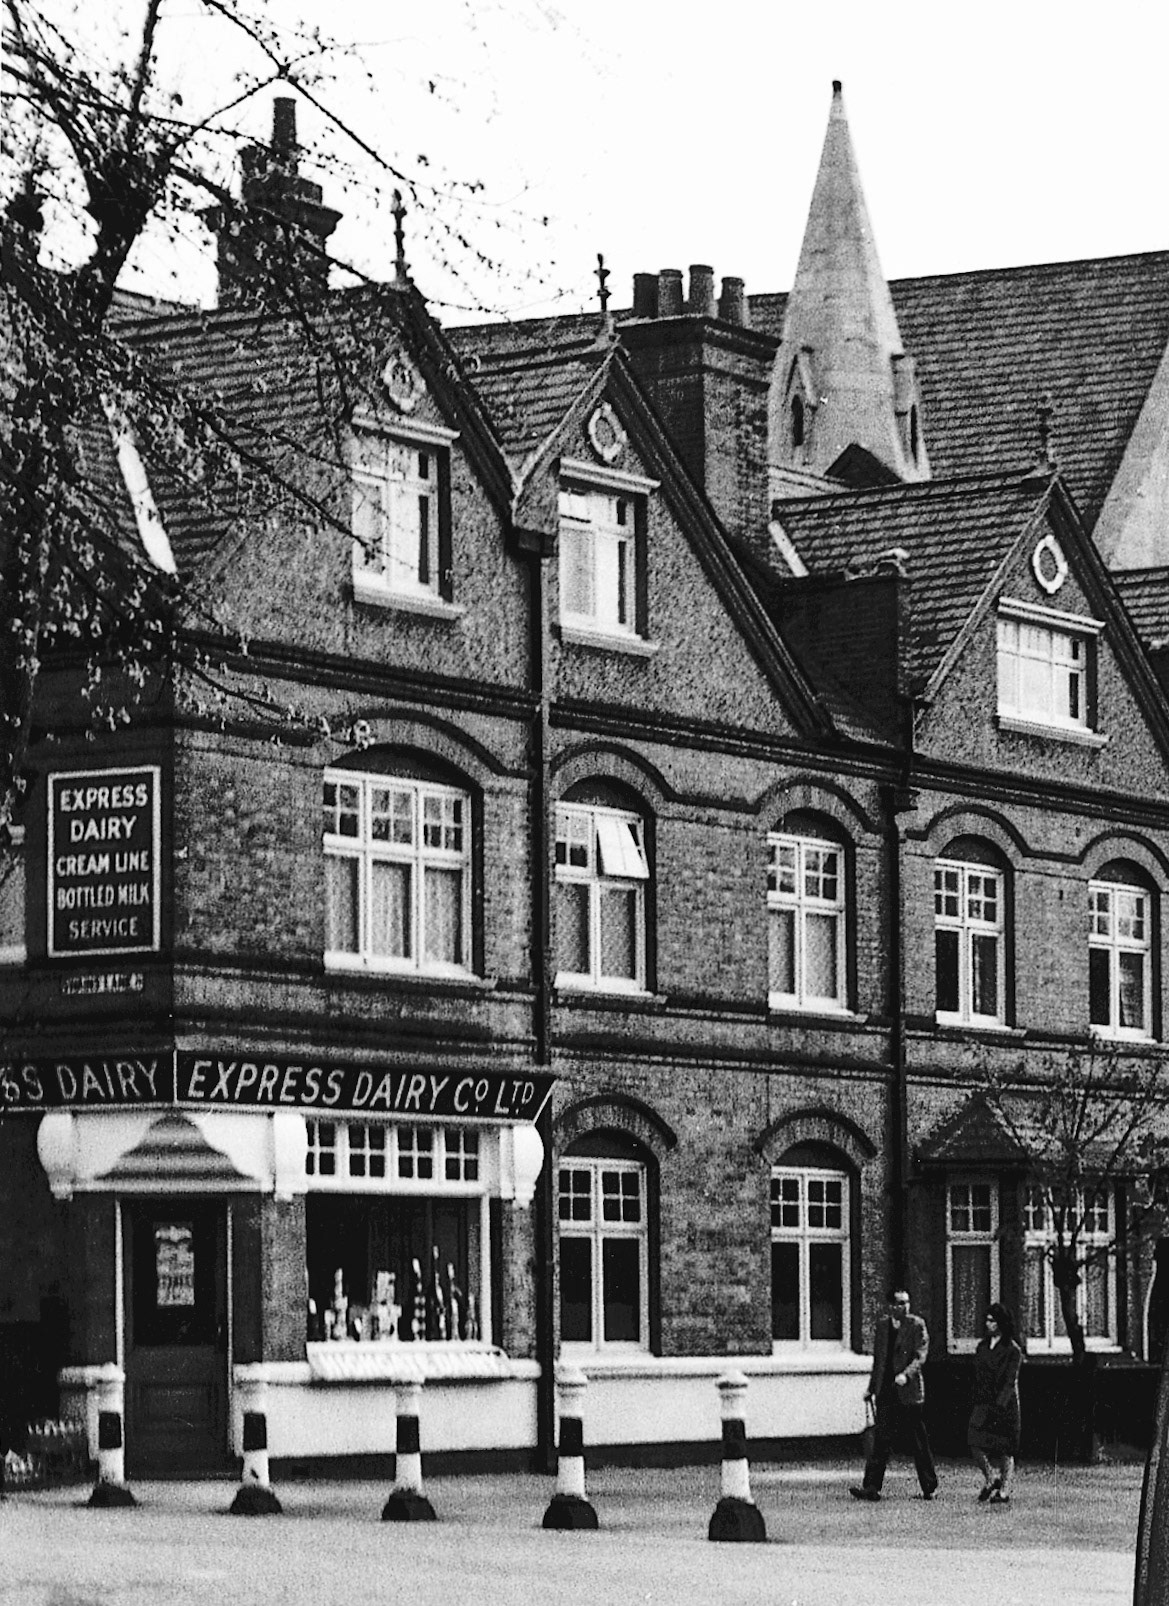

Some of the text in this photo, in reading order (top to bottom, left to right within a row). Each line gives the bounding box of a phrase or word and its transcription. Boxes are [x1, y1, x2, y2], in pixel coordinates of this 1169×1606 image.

[60, 783, 148, 812] EXPRESS
[70, 815, 137, 843] DAIRY
[56, 850, 149, 877] CREAM LINE
[57, 882, 149, 910] BOTTLED MILK
[69, 916, 138, 940] SERVICE
[56, 1060, 157, 1100] DAIRY
[188, 1060, 344, 1105] EXPRESS
[352, 1071, 449, 1111] DAIRY
